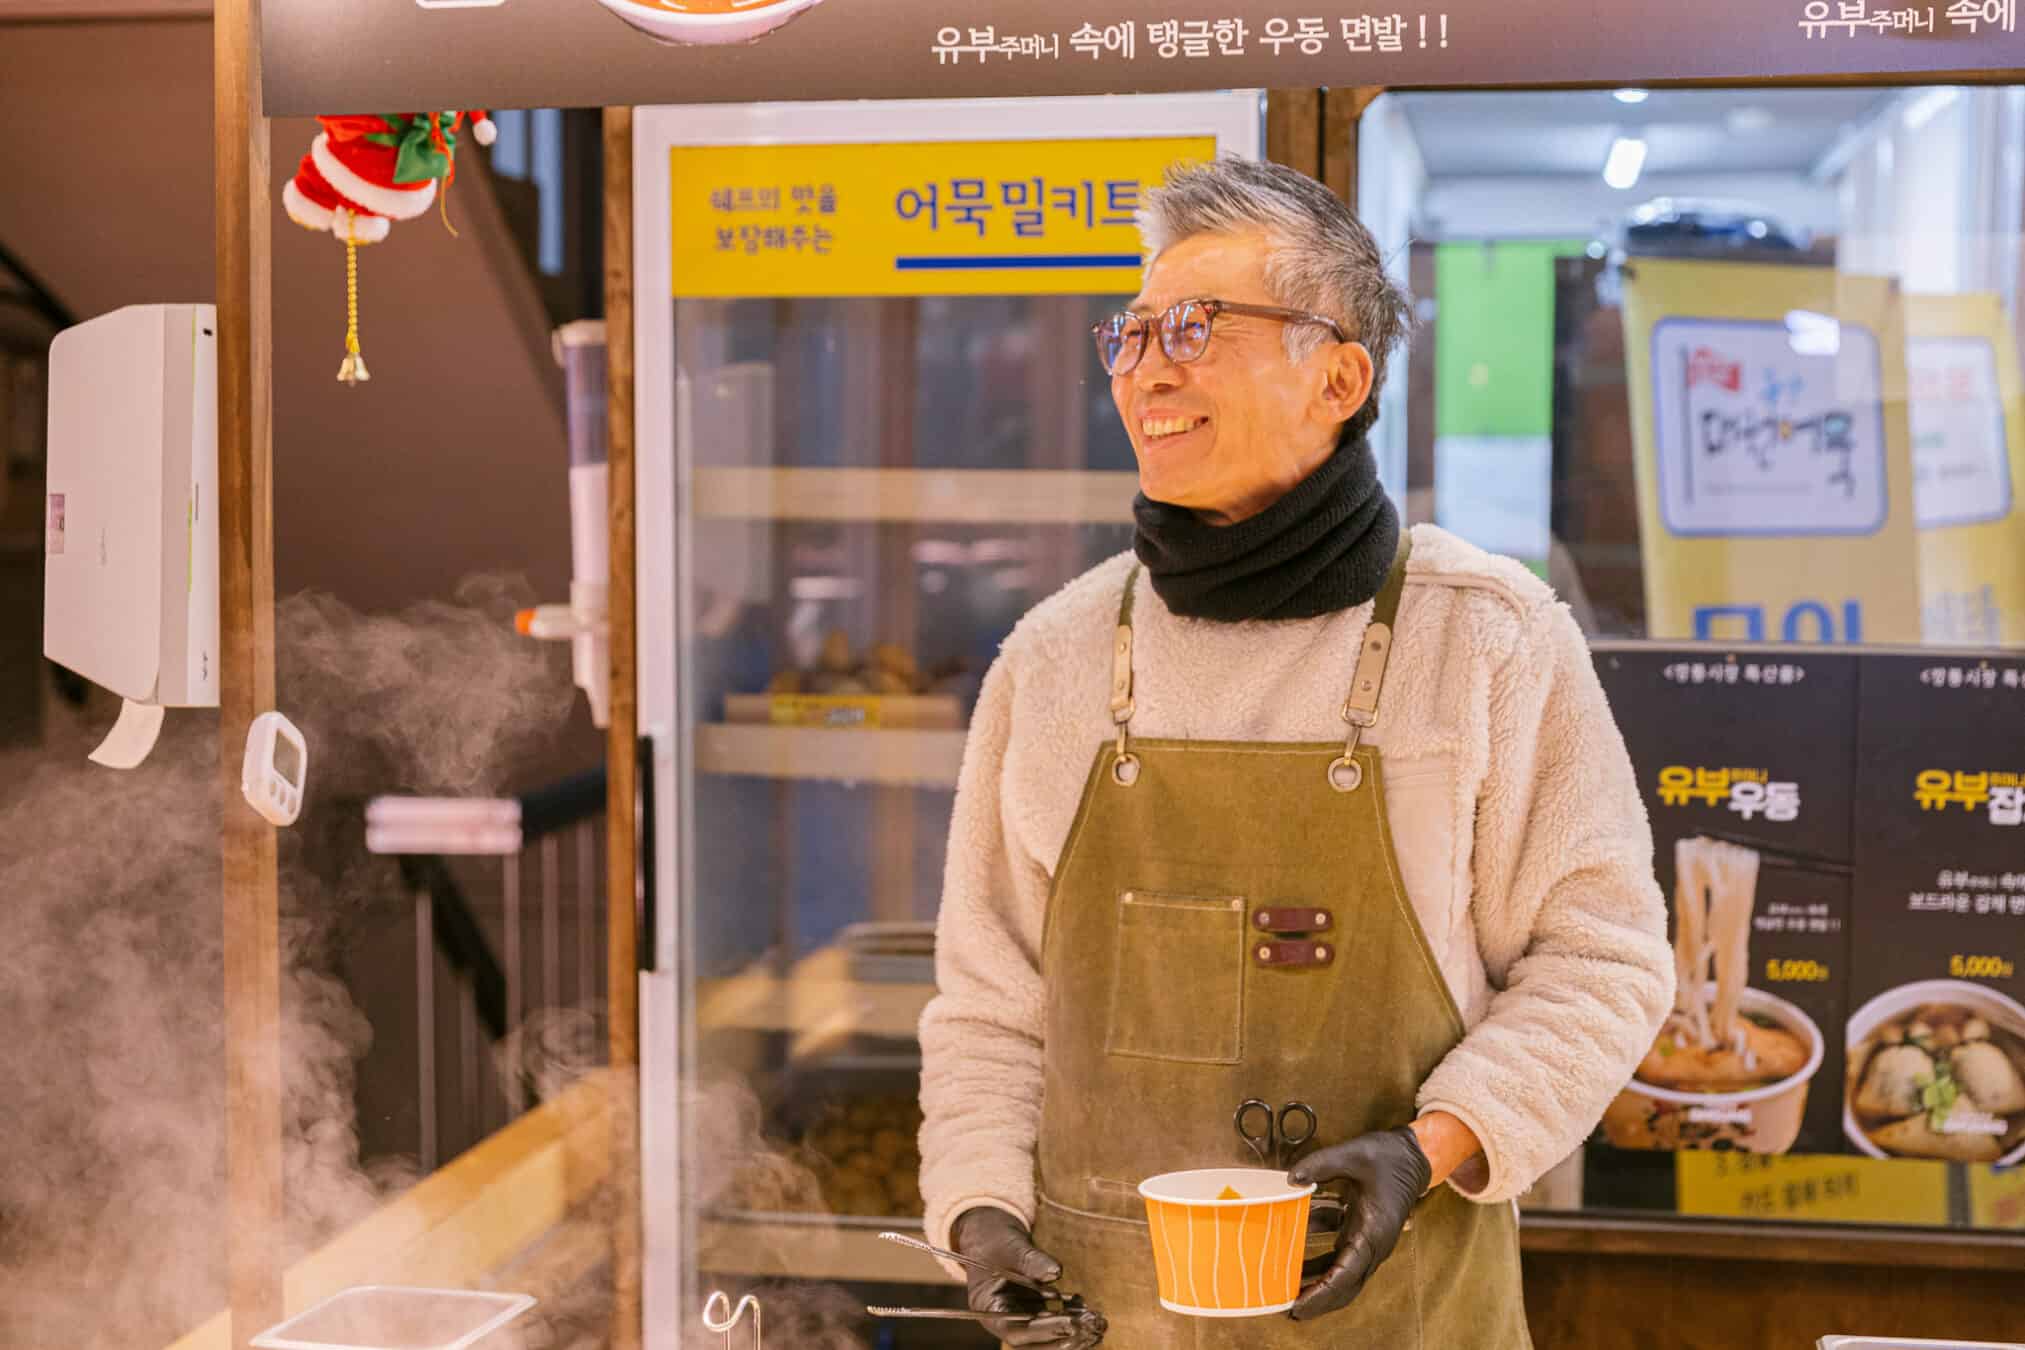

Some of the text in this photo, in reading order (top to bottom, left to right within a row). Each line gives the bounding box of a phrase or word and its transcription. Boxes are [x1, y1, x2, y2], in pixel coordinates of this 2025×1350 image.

[1798, 0, 2017, 39] 유부주머니 속에
[932, 26, 1059, 64] 유부주머니
[1069, 21, 1135, 59] 속에
[1147, 18, 1249, 58] 탱글한
[1259, 18, 1330, 55] 우동
[791, 184, 837, 213] 맛을
[895, 177, 1140, 237] 어묵밀키트
[715, 224, 833, 255] 보장해주는
[1988, 787, 2025, 826] 잡
